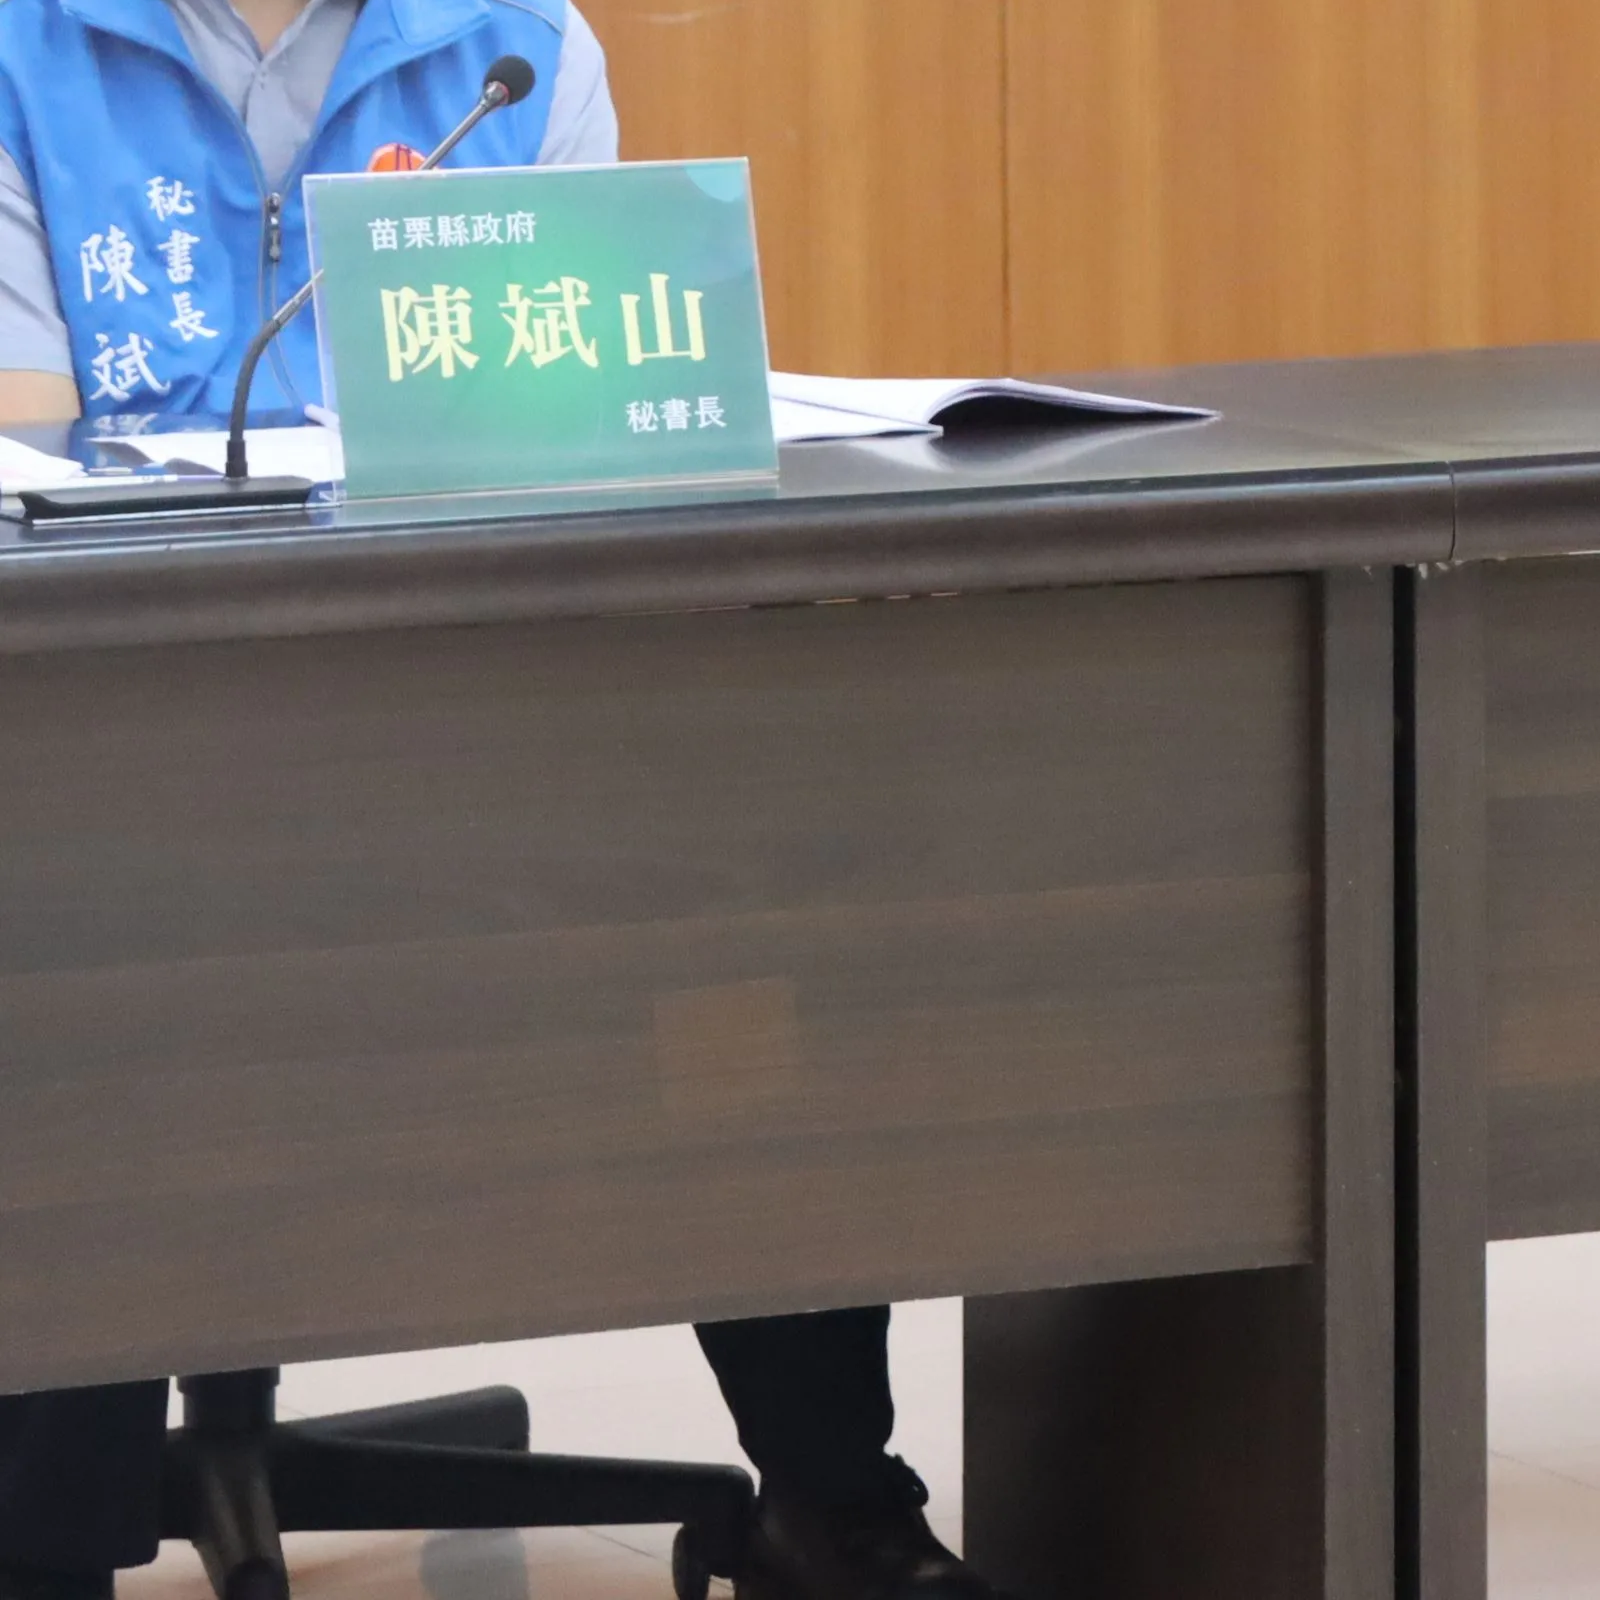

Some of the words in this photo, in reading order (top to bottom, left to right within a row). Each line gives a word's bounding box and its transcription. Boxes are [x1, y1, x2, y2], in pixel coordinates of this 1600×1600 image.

[368, 211, 537, 251] 苗栗縣政府
[79, 223, 171, 401] 陳斌
[380, 272, 707, 383] 陳斌山
[625, 395, 728, 434] 秘書長
